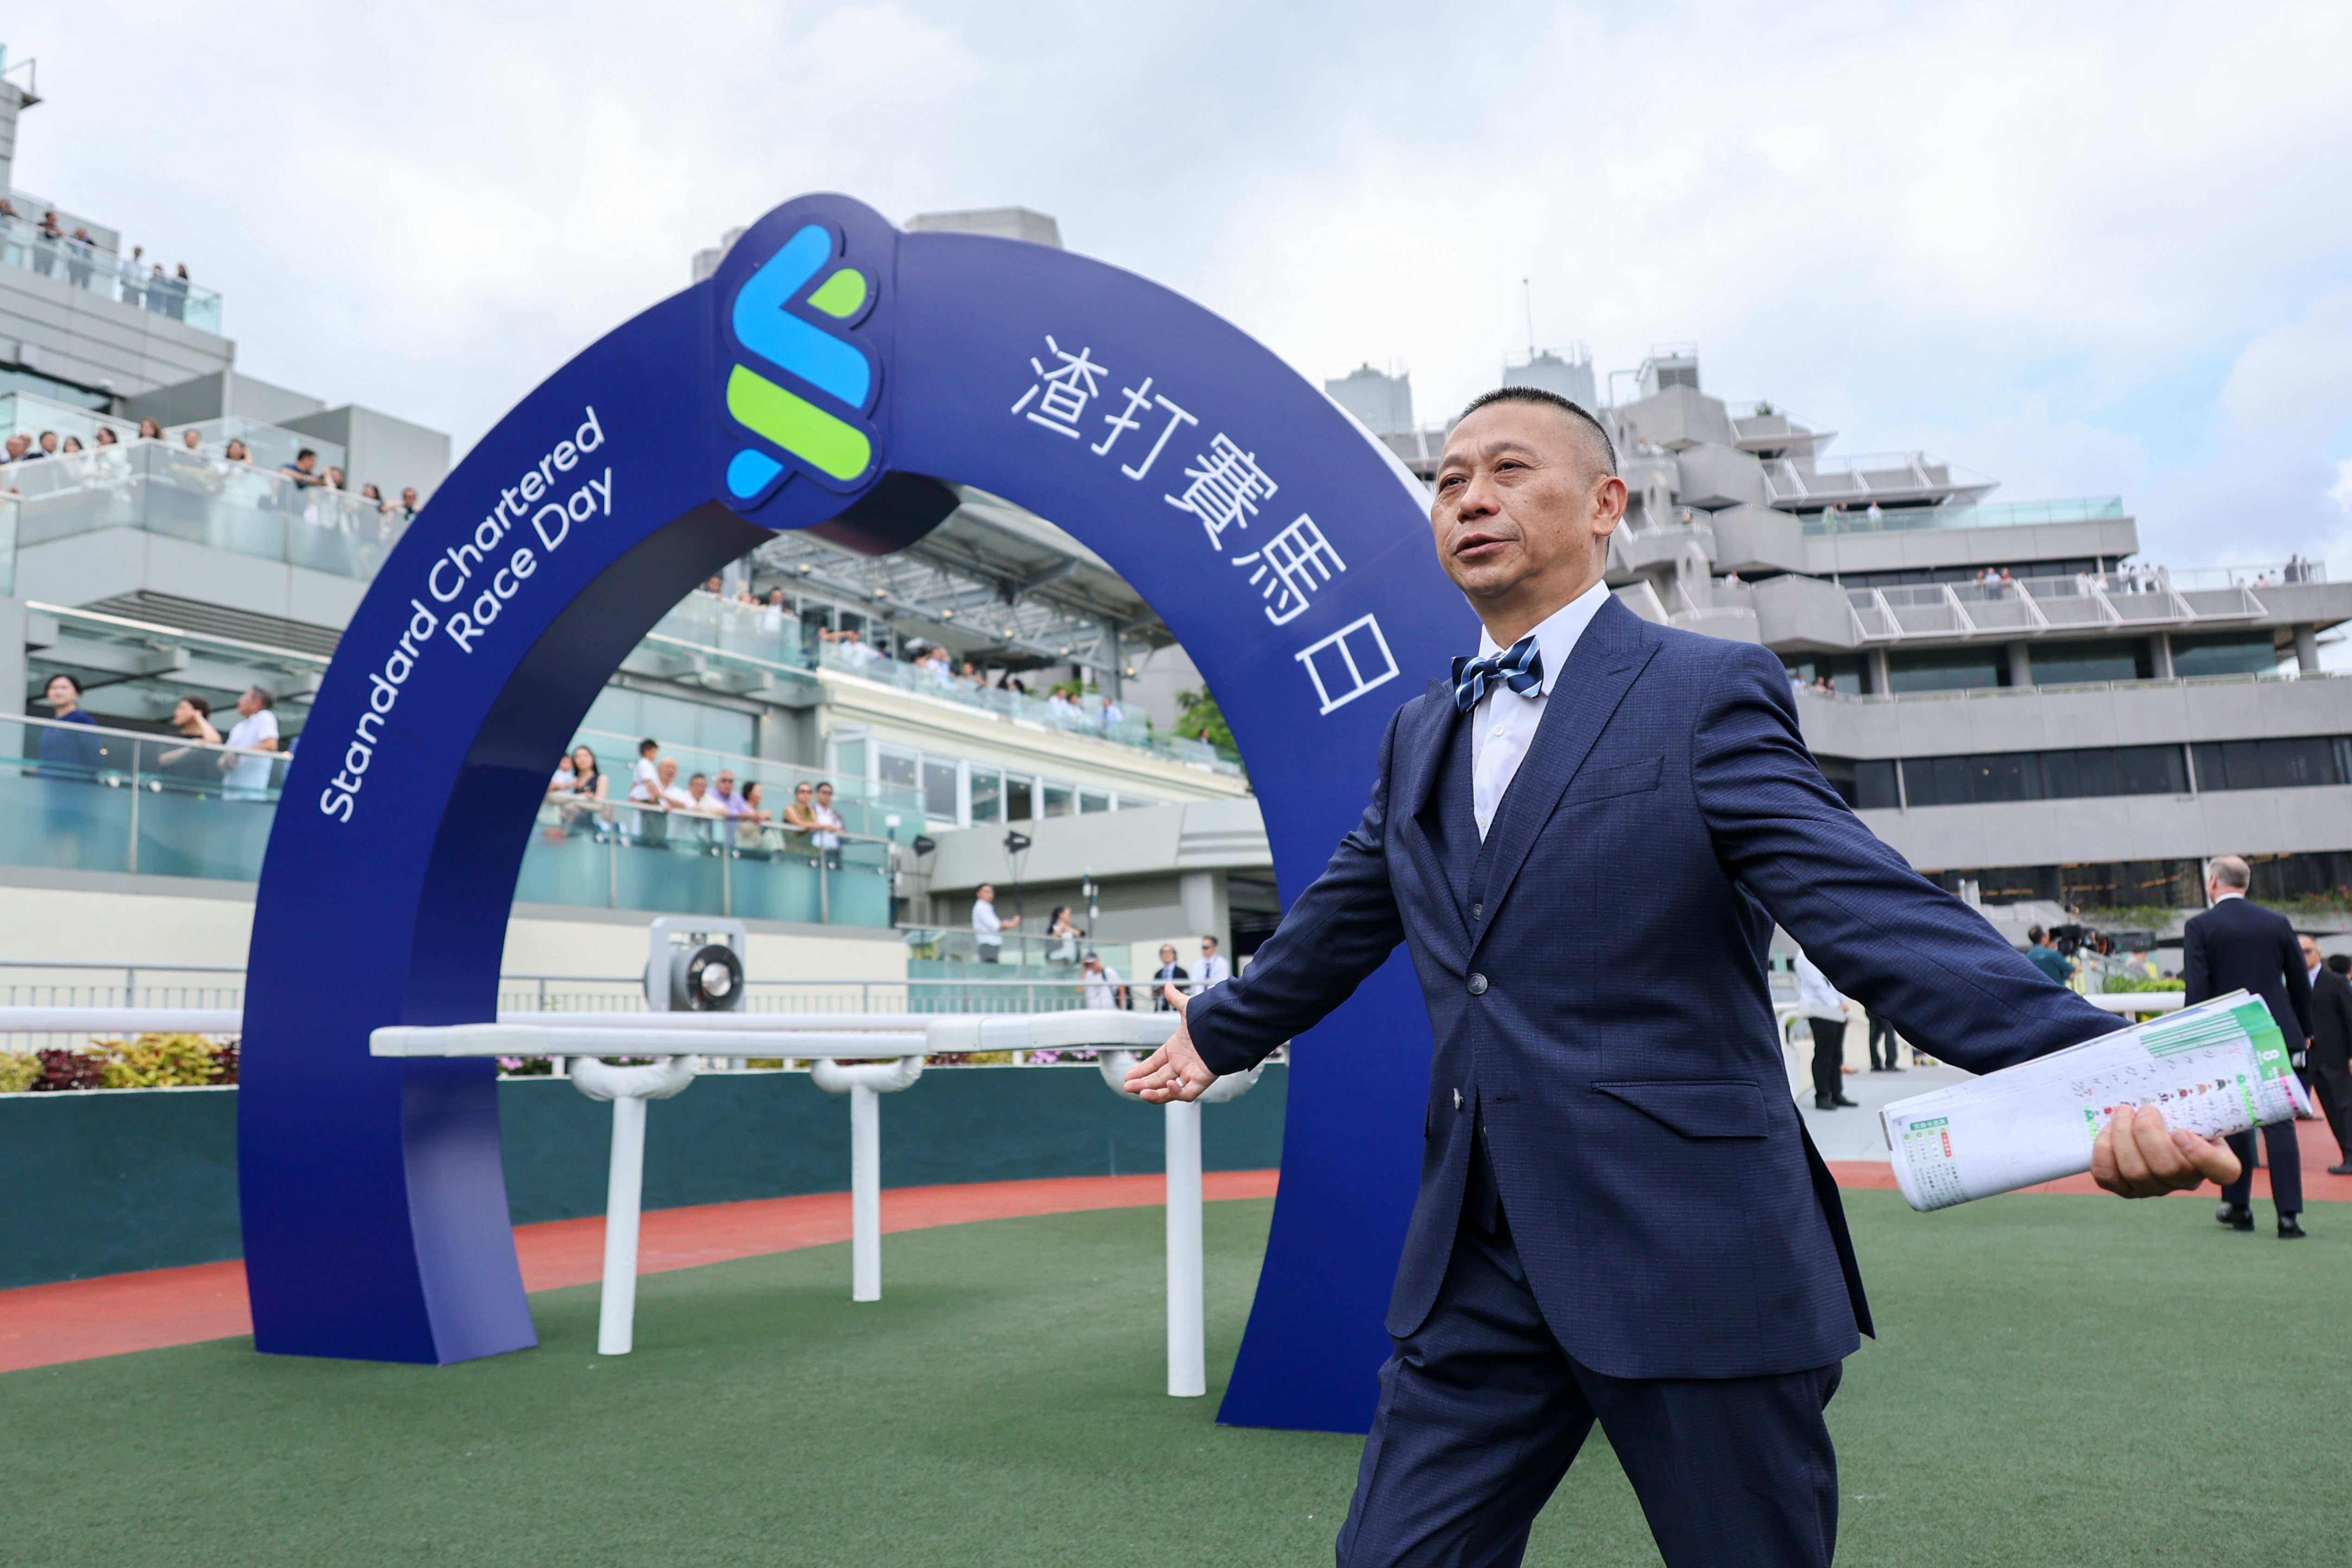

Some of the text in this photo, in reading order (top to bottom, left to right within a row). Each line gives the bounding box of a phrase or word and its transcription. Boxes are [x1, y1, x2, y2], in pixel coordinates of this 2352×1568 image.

[320, 406, 605, 823] Standard Chartered
[445, 467, 612, 653] Race Day
[1011, 335, 1399, 715] 渣打賽馬日
[2262, 1049, 2280, 1061] 8
